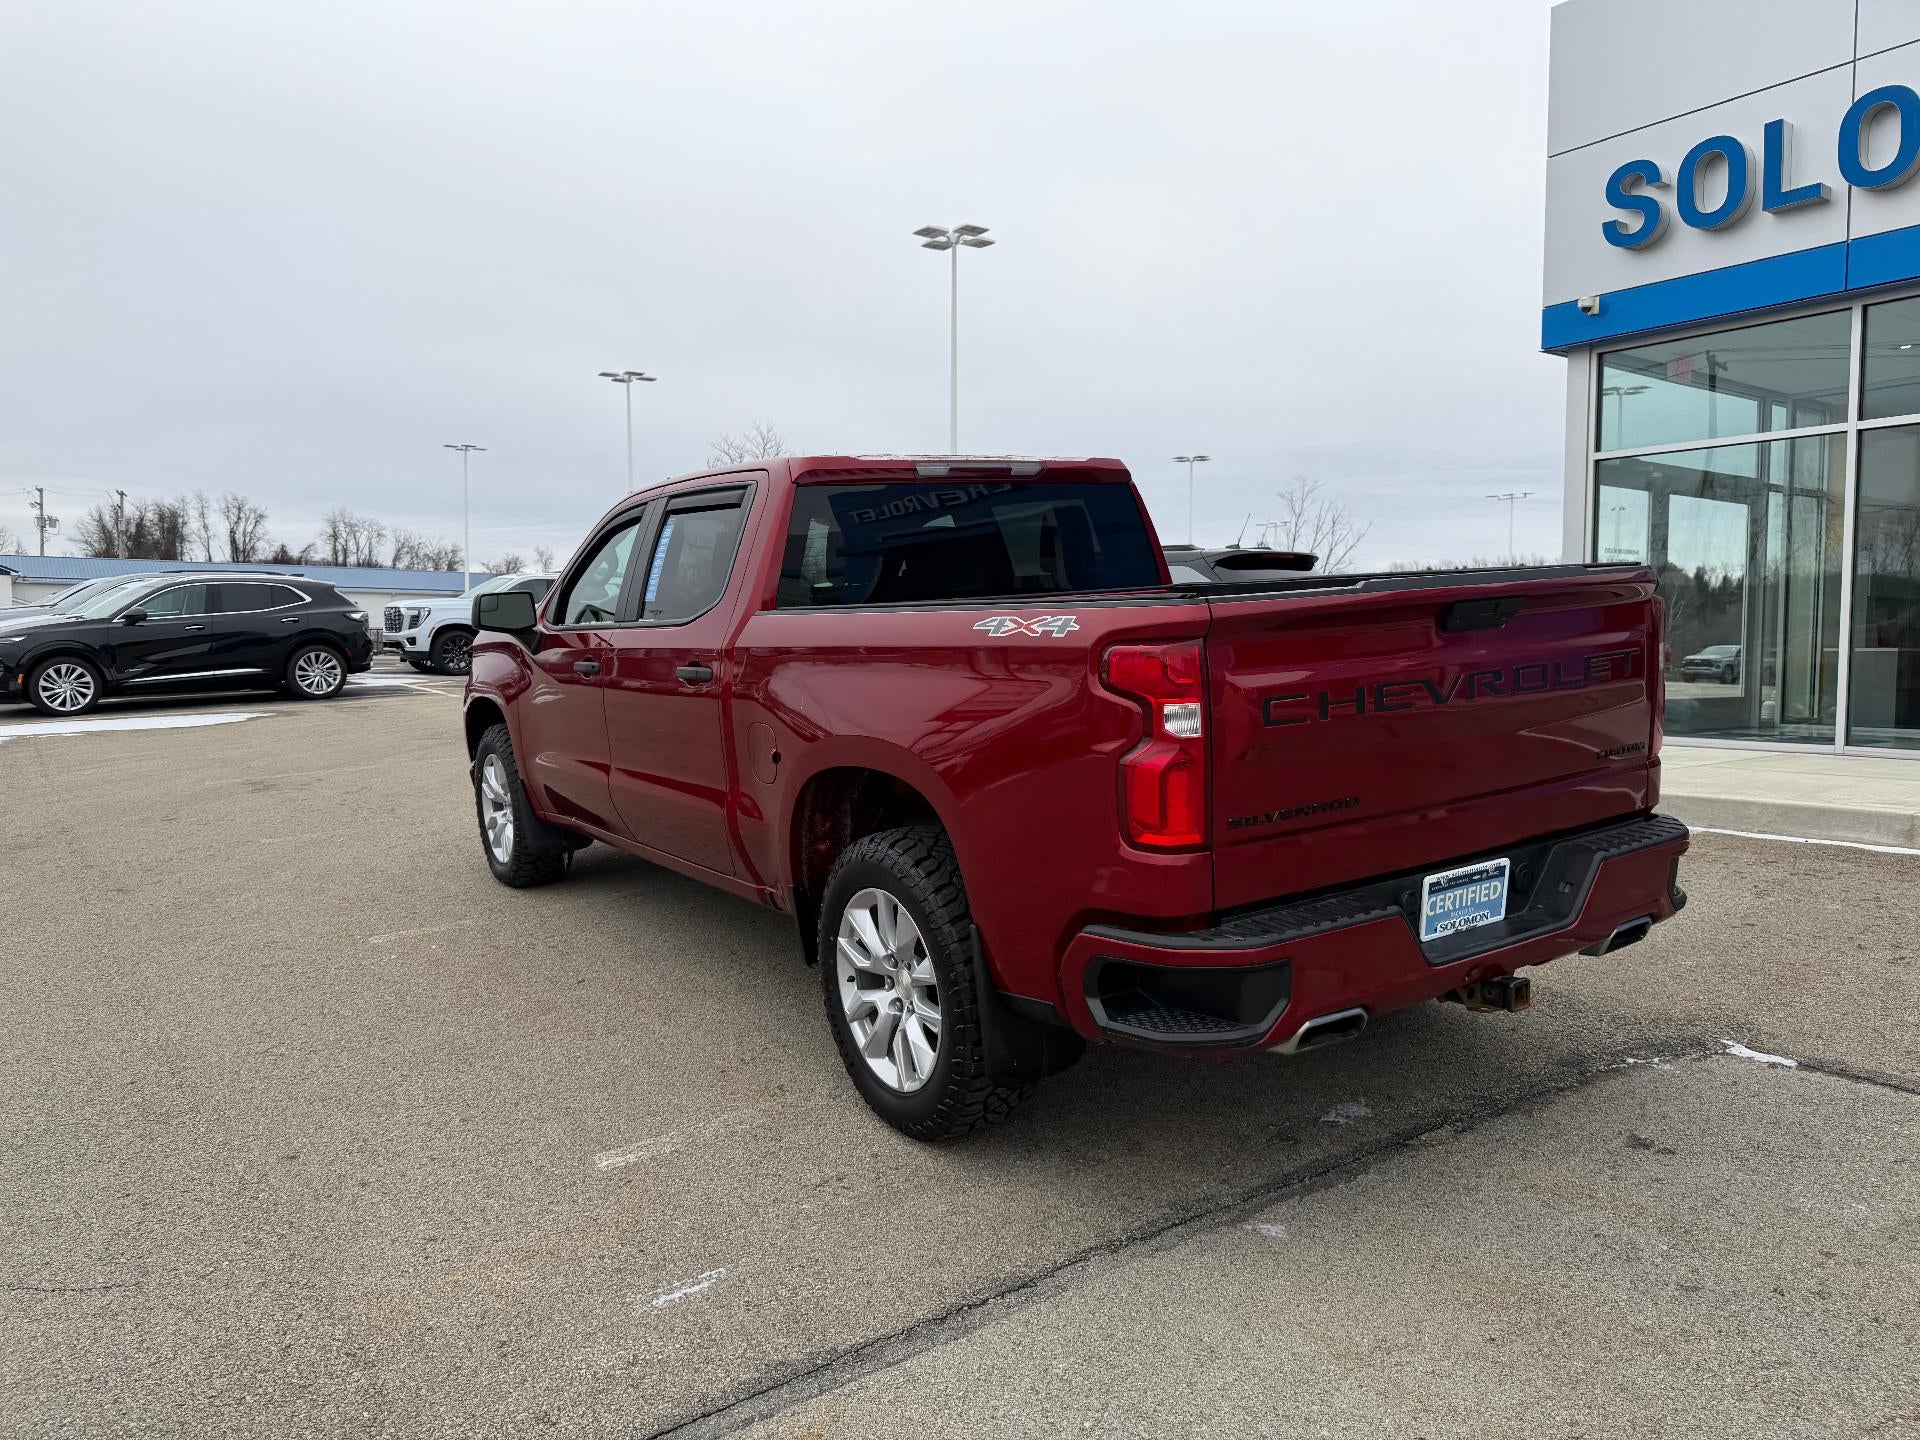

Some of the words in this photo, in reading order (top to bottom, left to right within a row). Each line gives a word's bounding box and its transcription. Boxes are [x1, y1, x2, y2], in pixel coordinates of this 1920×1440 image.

[1262, 647, 1641, 728] CHEVROLET
[1227, 796, 1361, 831] SILVERADO
[1427, 881, 1502, 917] CERTIFIED
[1439, 911, 1490, 933] SOLOMON
